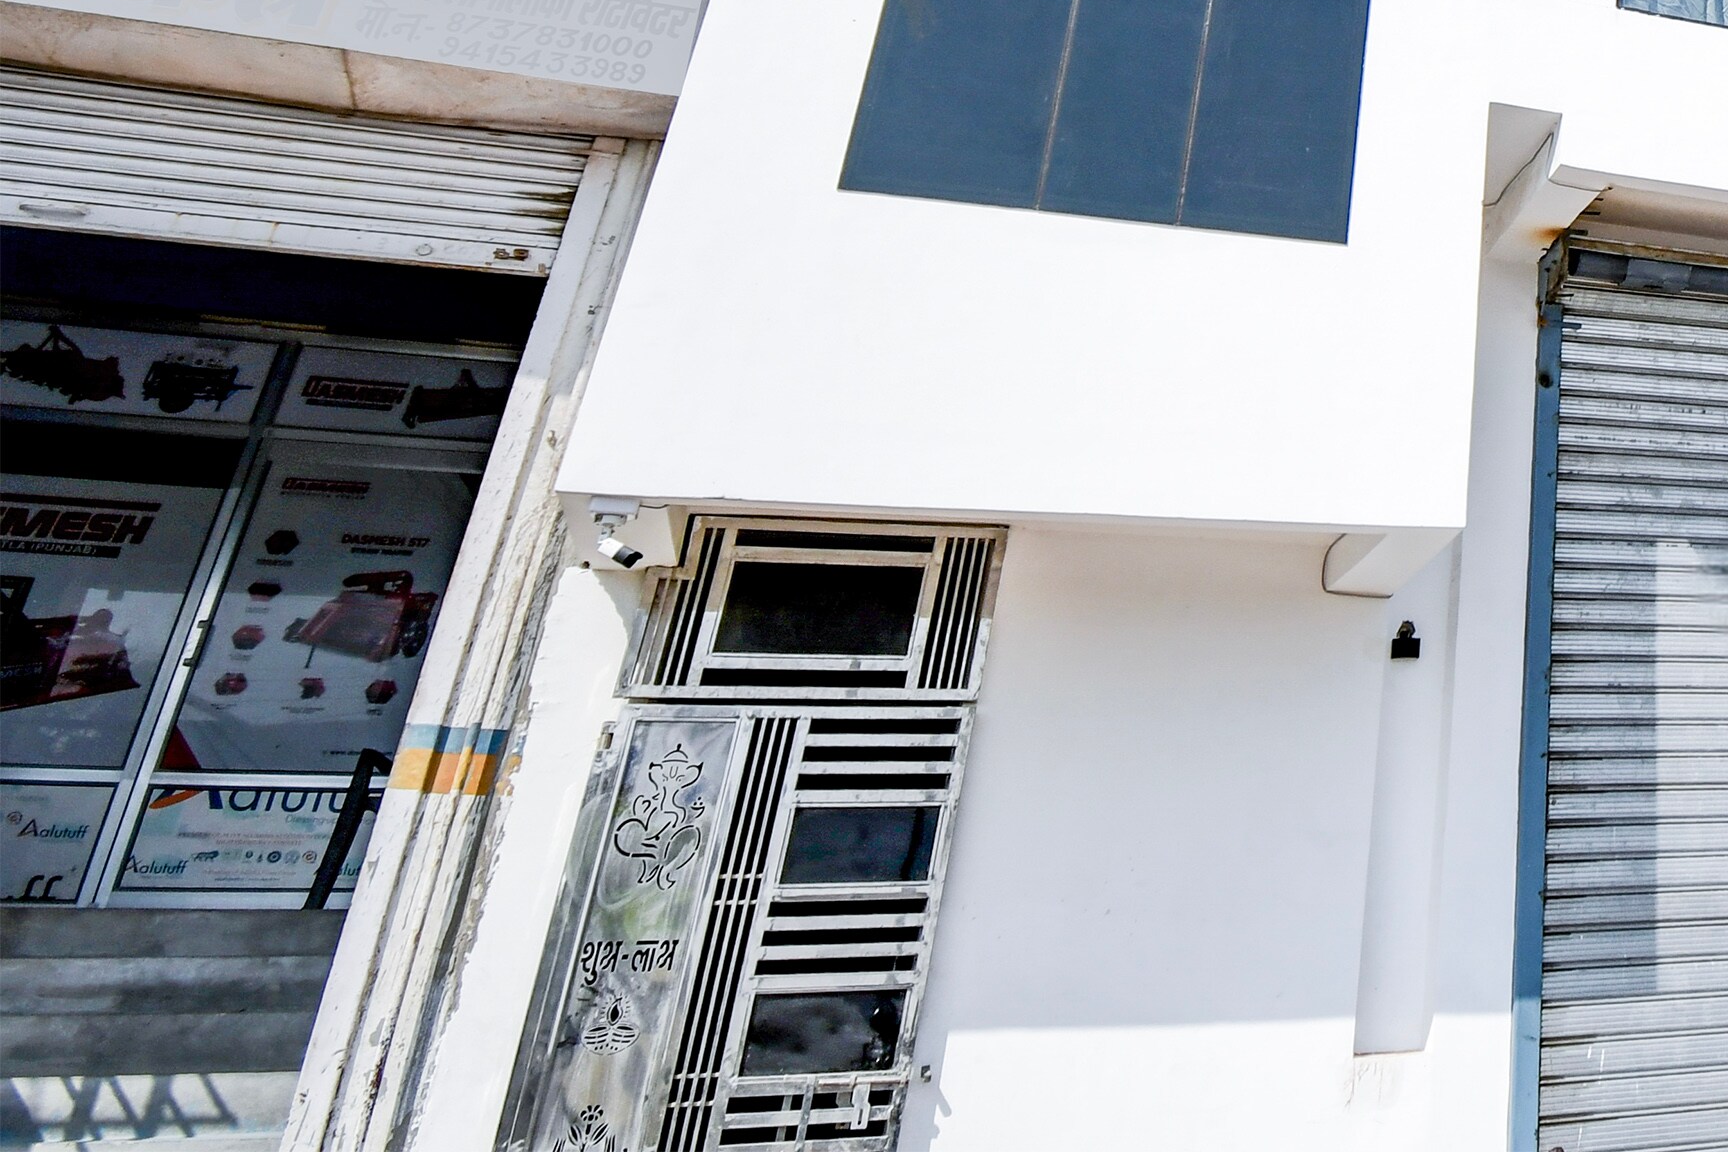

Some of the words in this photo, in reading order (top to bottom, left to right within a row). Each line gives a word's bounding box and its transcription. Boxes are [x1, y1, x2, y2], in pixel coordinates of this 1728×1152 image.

[446, 11, 654, 59] 8737831000
[438, 36, 647, 84] 9415433989
[0, 506, 155, 545] MESH
